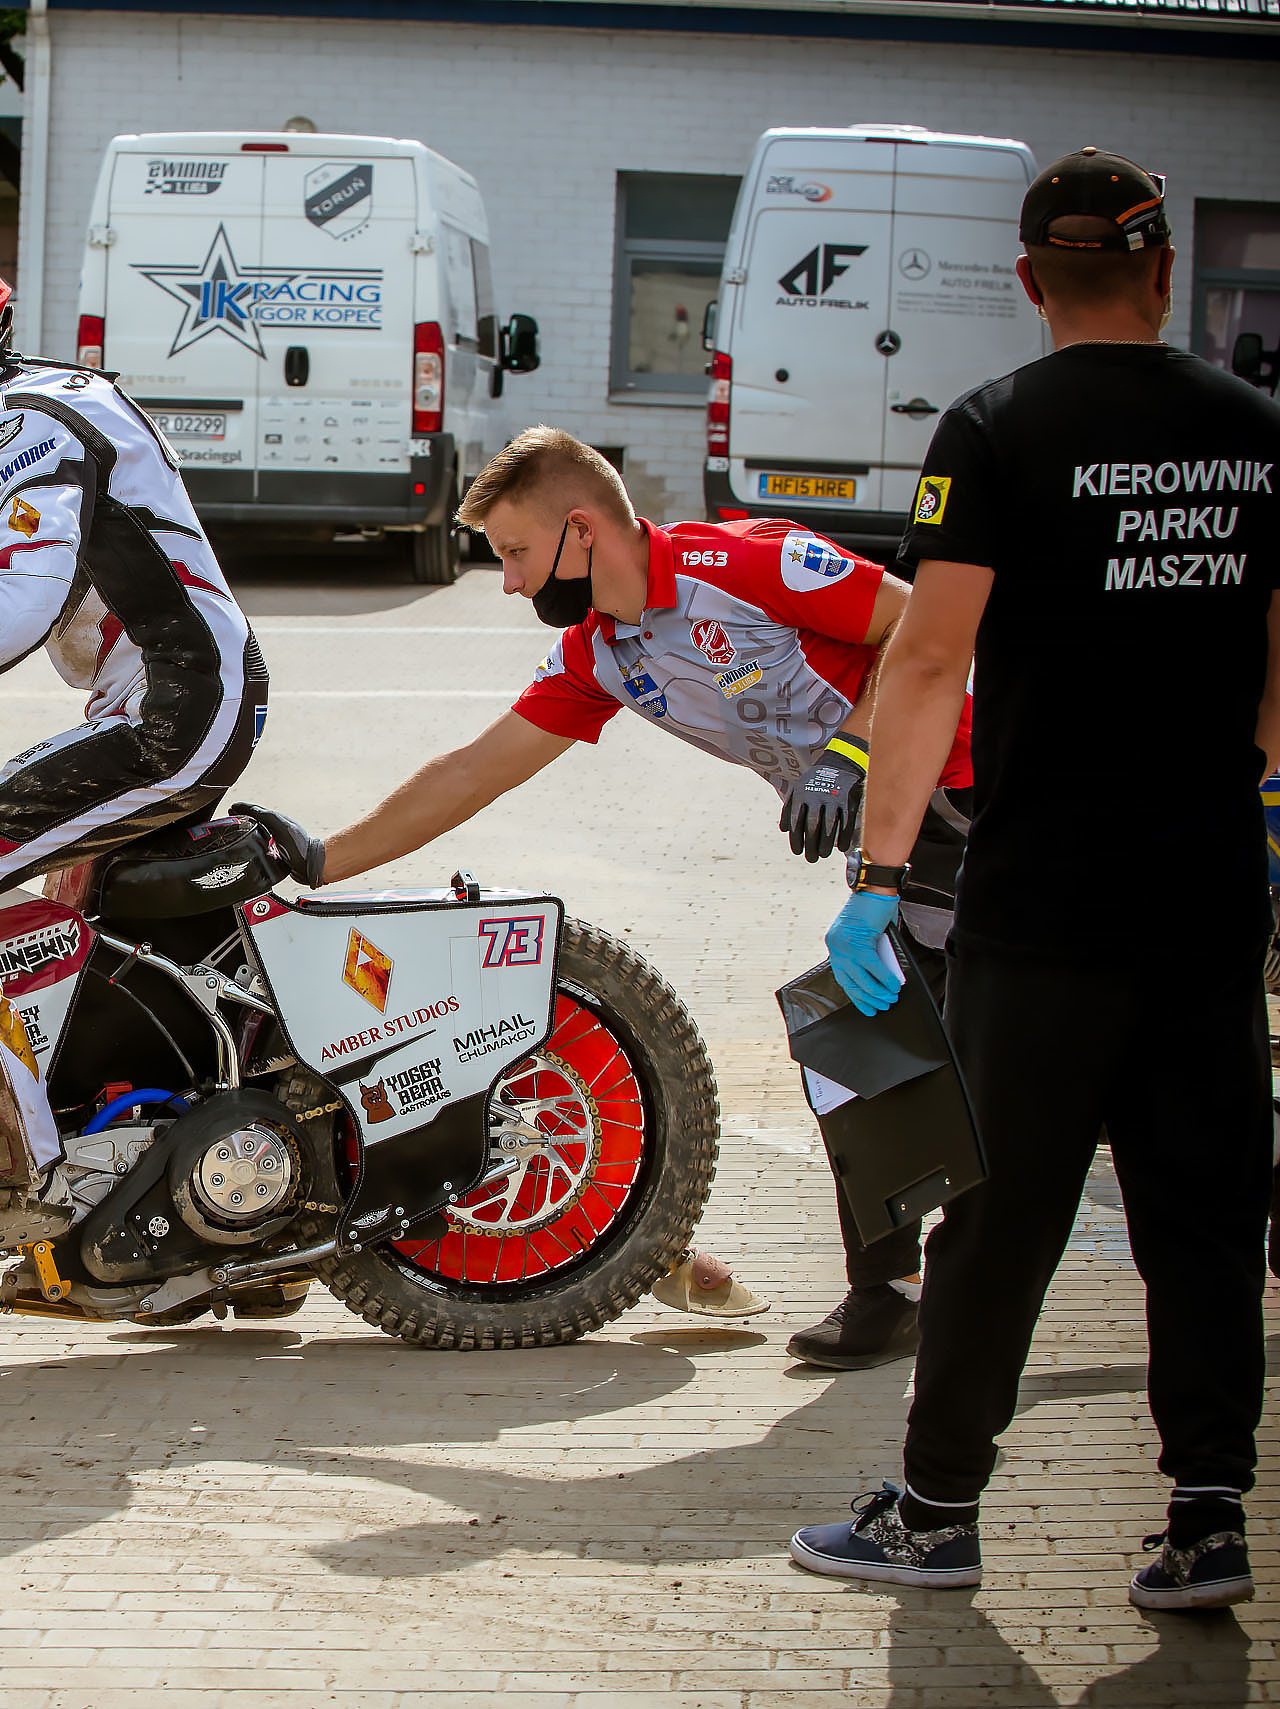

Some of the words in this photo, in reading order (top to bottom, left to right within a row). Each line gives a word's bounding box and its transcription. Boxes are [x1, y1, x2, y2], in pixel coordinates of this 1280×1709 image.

[252, 282, 382, 303] RACING
[776, 297, 818, 307] AUTO
[820, 299, 870, 310] FRELIK
[254, 306, 307, 321] IGOR
[174, 416, 223, 432] 02299
[814, 479, 848, 496] HRE
[1072, 459, 1274, 498] KIEROWNIK
[1116, 506, 1239, 543] PARKU
[680, 551, 729, 567] 1963
[1104, 554, 1247, 591] MASZYN
[479, 915, 545, 968] 73
[320, 1027, 382, 1063] AMBER
[384, 995, 460, 1037] STUDIOS
[452, 1013, 535, 1053] MIHAIL
[458, 1026, 537, 1064] CHUMAKOV
[385, 1057, 442, 1093] YOGGY
[397, 1076, 445, 1107] BEAR
